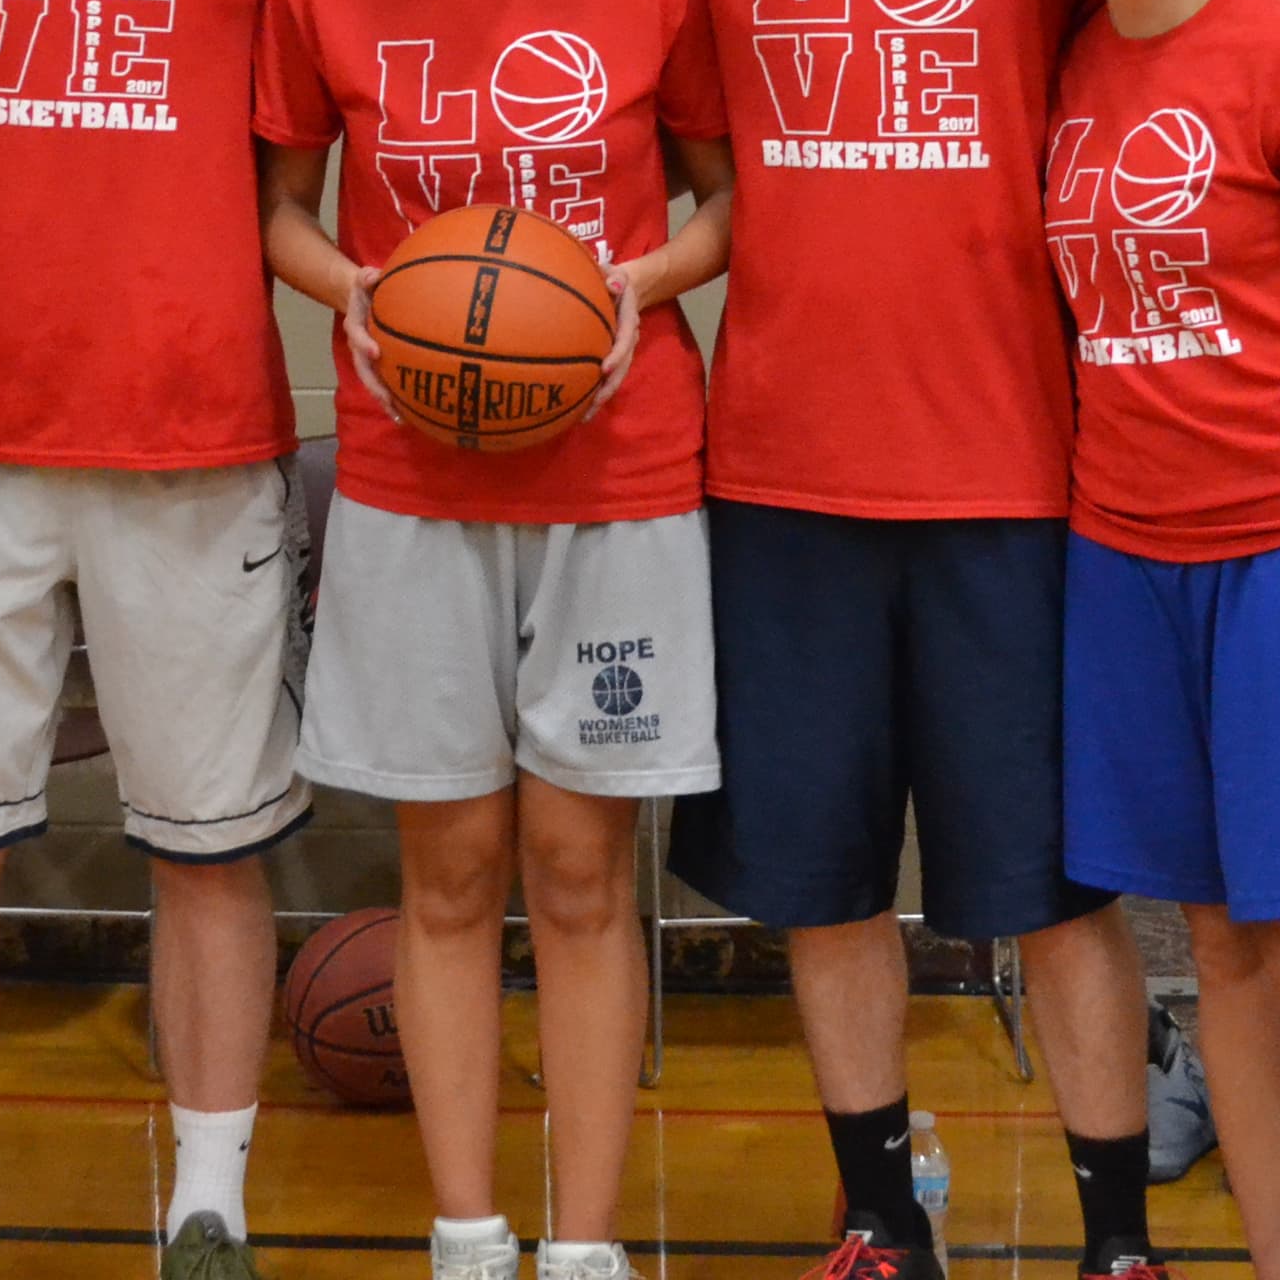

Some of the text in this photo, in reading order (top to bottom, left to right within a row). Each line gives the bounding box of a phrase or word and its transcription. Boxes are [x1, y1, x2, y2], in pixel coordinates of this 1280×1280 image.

[82, 0, 102, 92] SPRING
[126, 79, 162, 95] 2017
[890, 37, 909, 132] SPRING
[938, 117, 973, 132] 2017
[761, 139, 991, 170] BASKETBALL
[567, 220, 600, 237] 2017
[1180, 306, 1215, 325] 2017
[396, 365, 565, 421] THE ROCK
[577, 637, 655, 664] HOPE
[578, 714, 661, 732] WOMENS
[579, 728, 662, 745] BASKETBALL
